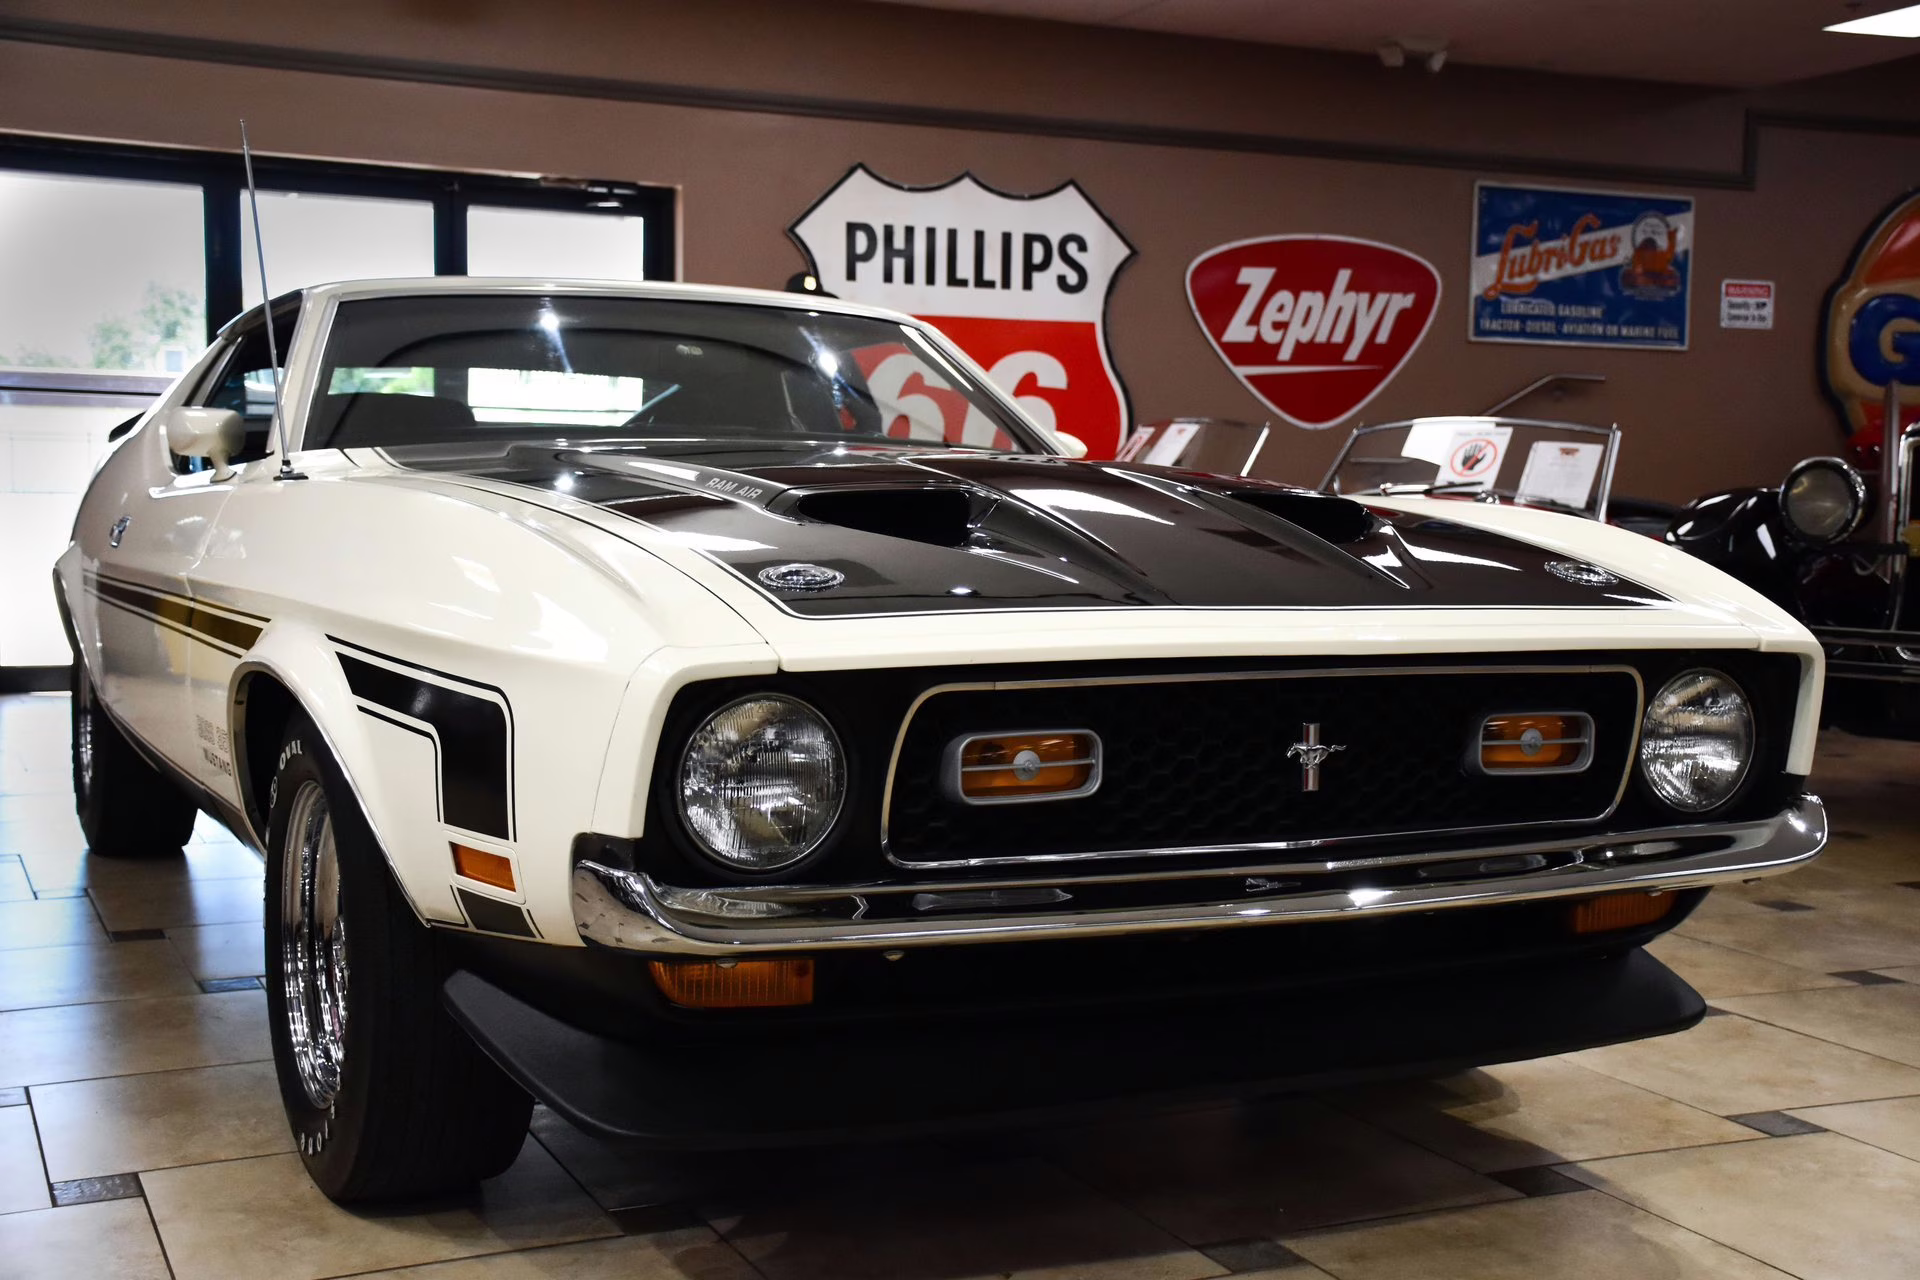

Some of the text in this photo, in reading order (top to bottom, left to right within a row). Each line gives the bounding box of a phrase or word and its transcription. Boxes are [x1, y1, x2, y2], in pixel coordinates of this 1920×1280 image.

[846, 221, 1088, 294] PHILLIPS
[1221, 267, 1416, 362] Zephyr
[1501, 303, 1603, 318] LUBRICATED GASOLINE
[1480, 319, 1679, 339] TRACTOR DIESEL AVIATION OR MARINE FUEL
[867, 351, 1068, 451] 66
[705, 477, 763, 500] RAM AIR
[280, 740, 302, 770] OVAL
